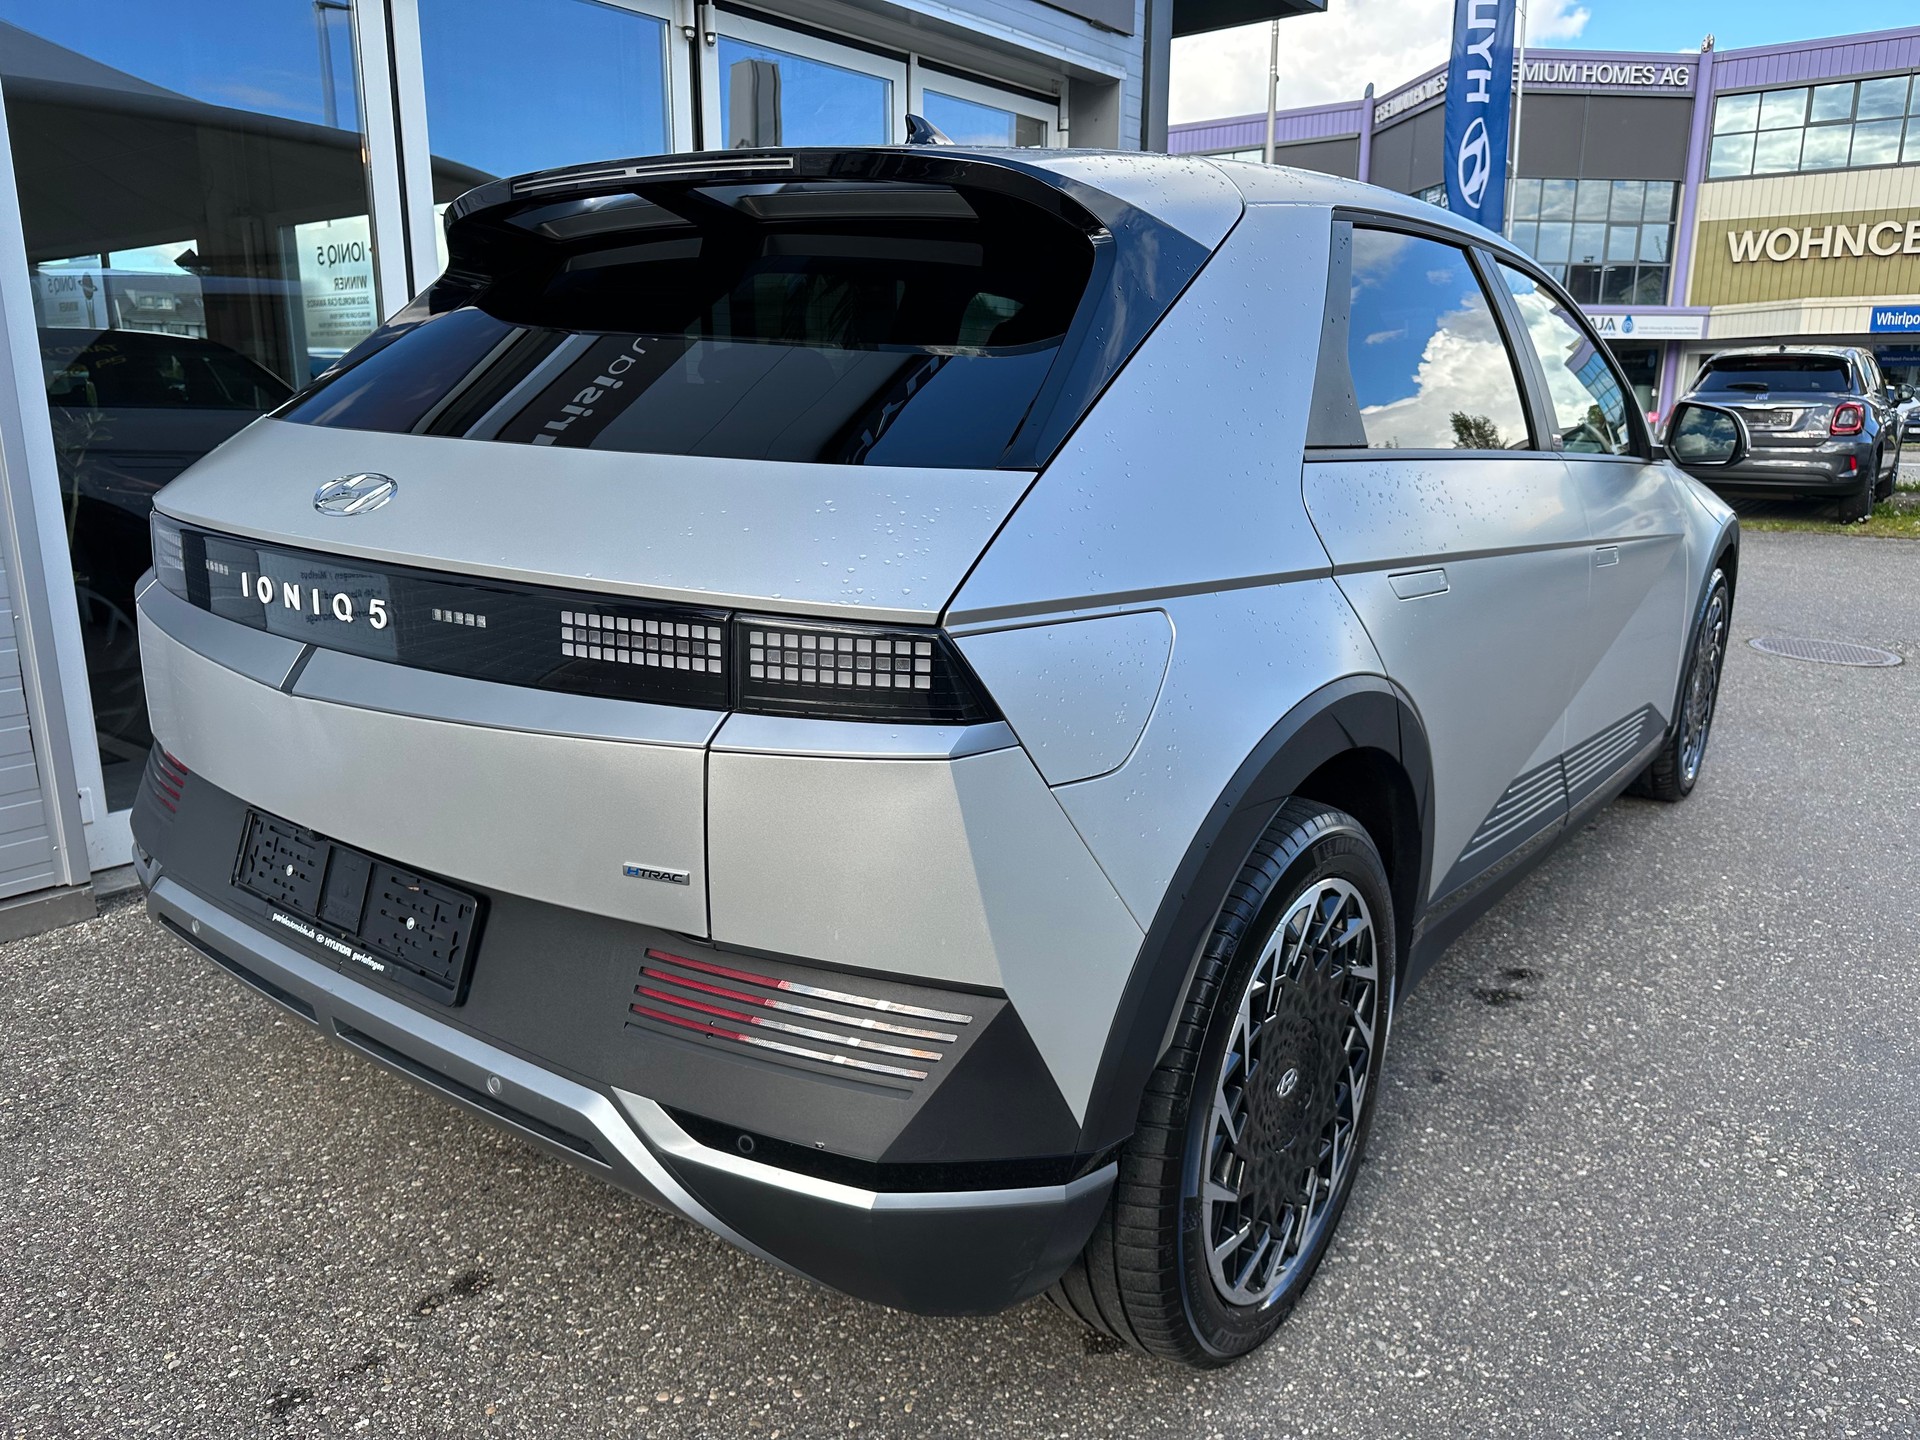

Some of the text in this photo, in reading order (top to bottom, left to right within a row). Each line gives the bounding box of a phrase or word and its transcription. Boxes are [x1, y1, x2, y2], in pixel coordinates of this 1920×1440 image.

[1581, 64, 1655, 85] HOMES
[1659, 66, 1689, 86] AG
[241, 571, 388, 630] IONIQ 5
[626, 866, 683, 883] HTRAC
[324, 937, 352, 957] HYUNDAI
